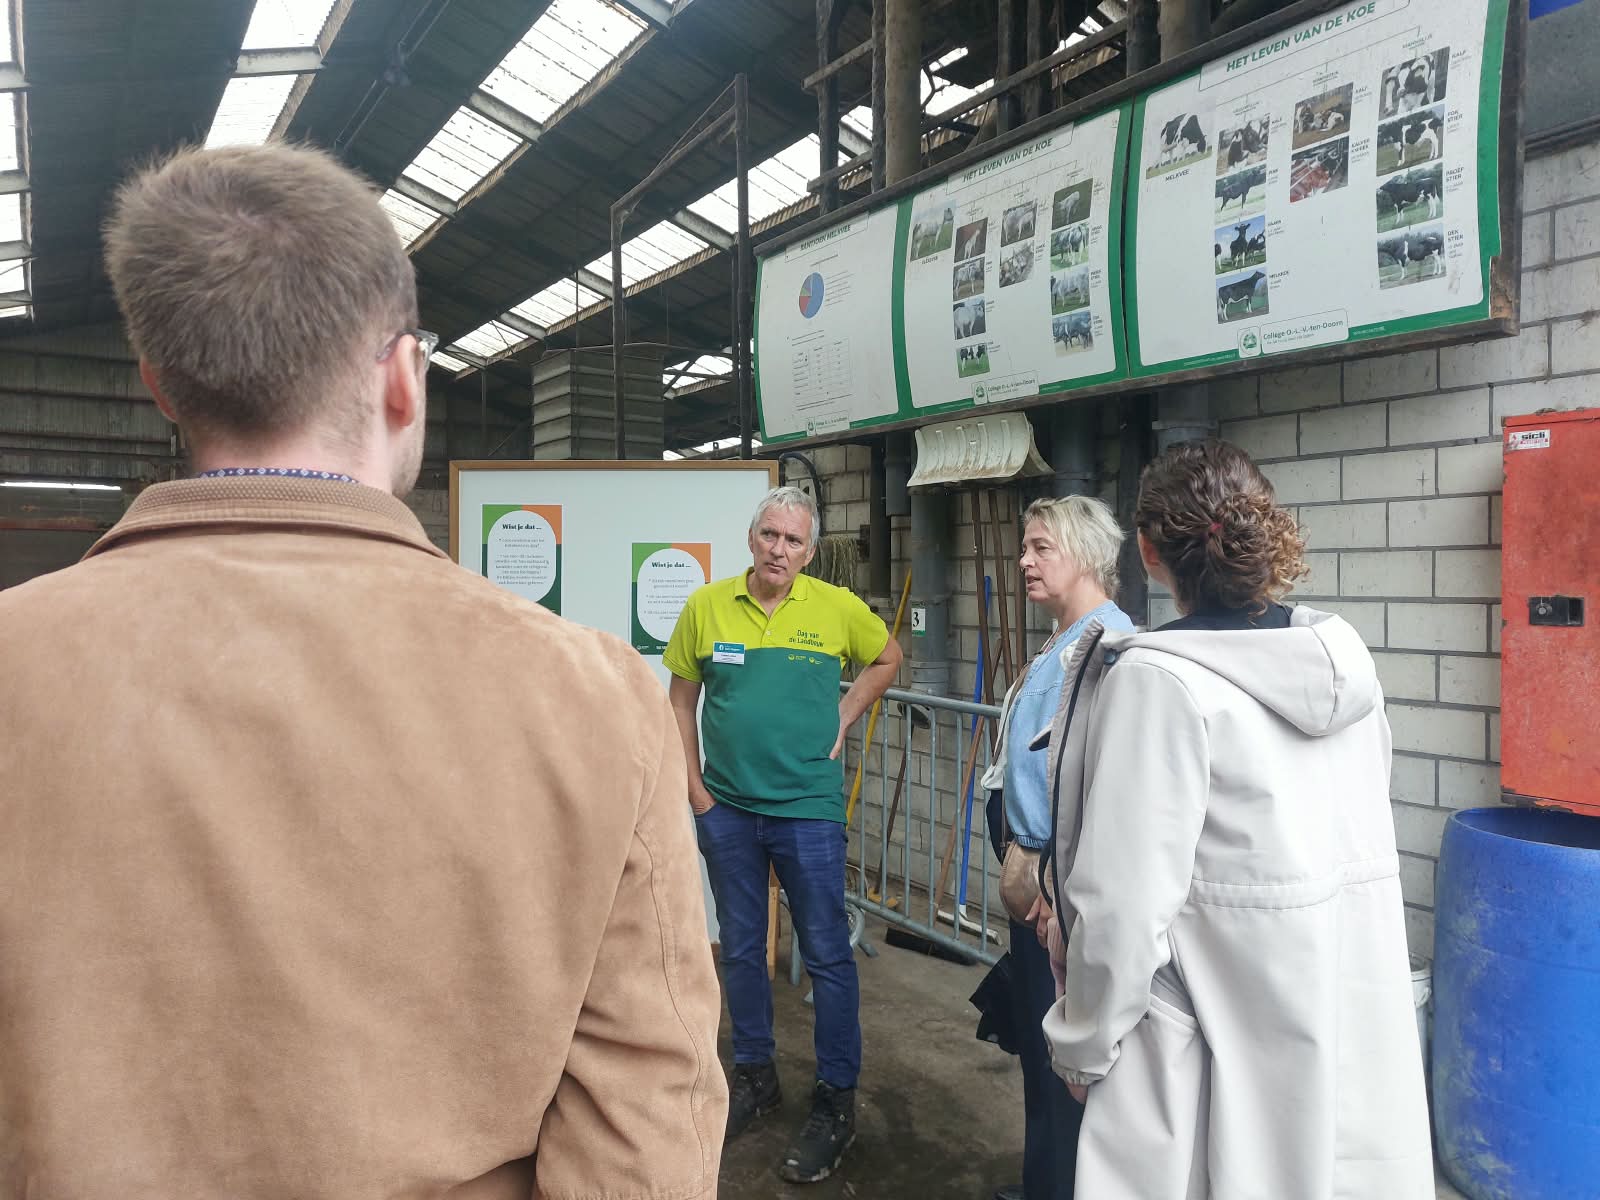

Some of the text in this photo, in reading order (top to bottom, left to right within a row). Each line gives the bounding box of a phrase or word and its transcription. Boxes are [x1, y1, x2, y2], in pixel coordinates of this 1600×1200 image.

[1226, 2, 1376, 72] HET LEVEN VAN DE KOE
[963, 137, 1053, 182] HET LEVEN VAN DE KOE
[1165, 169, 1190, 182] MELKVEE
[1263, 331, 1285, 340] College
[912, 611, 920, 627] 3
[797, 629, 808, 638] Dag
[797, 637, 824, 647] Landbouw
